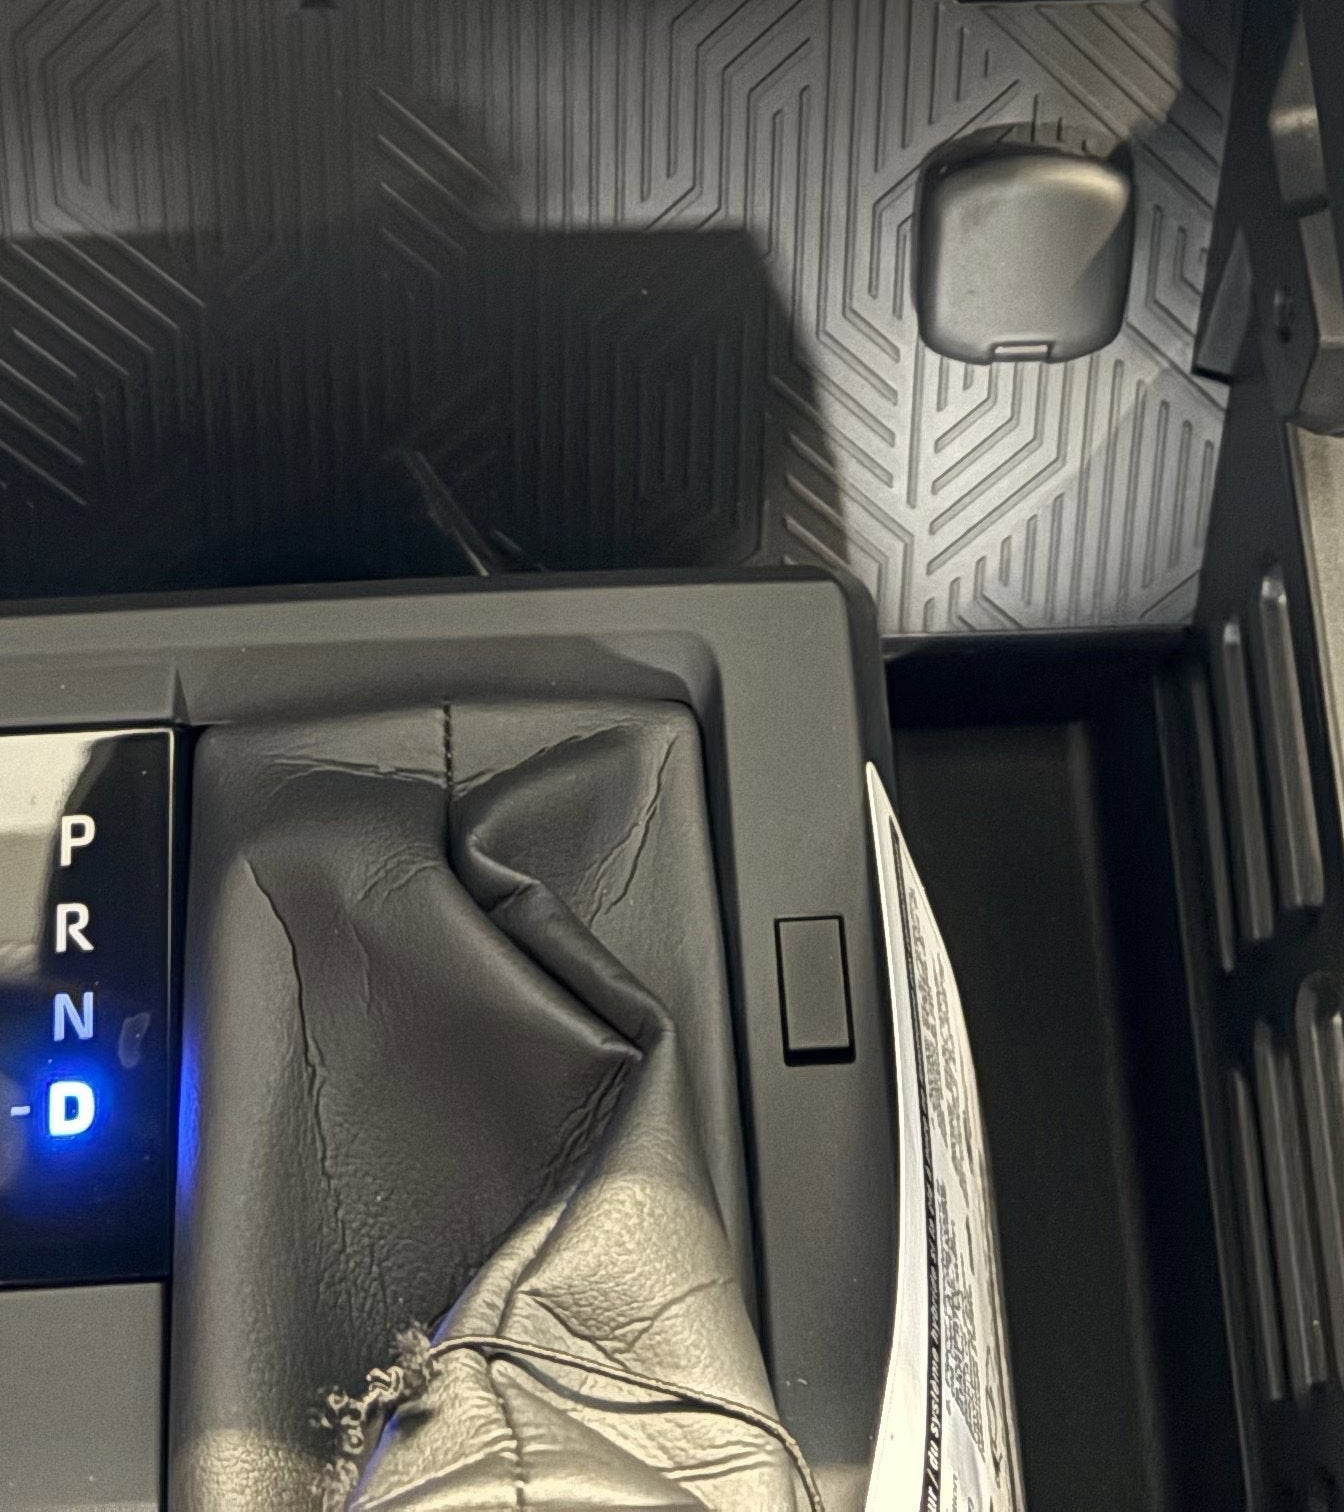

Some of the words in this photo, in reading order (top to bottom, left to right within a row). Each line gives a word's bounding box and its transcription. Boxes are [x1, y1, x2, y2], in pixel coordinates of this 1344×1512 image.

[59, 813, 97, 868] P
[55, 902, 95, 954] R
[53, 990, 95, 1043] N
[47, 1079, 97, 1138] D
